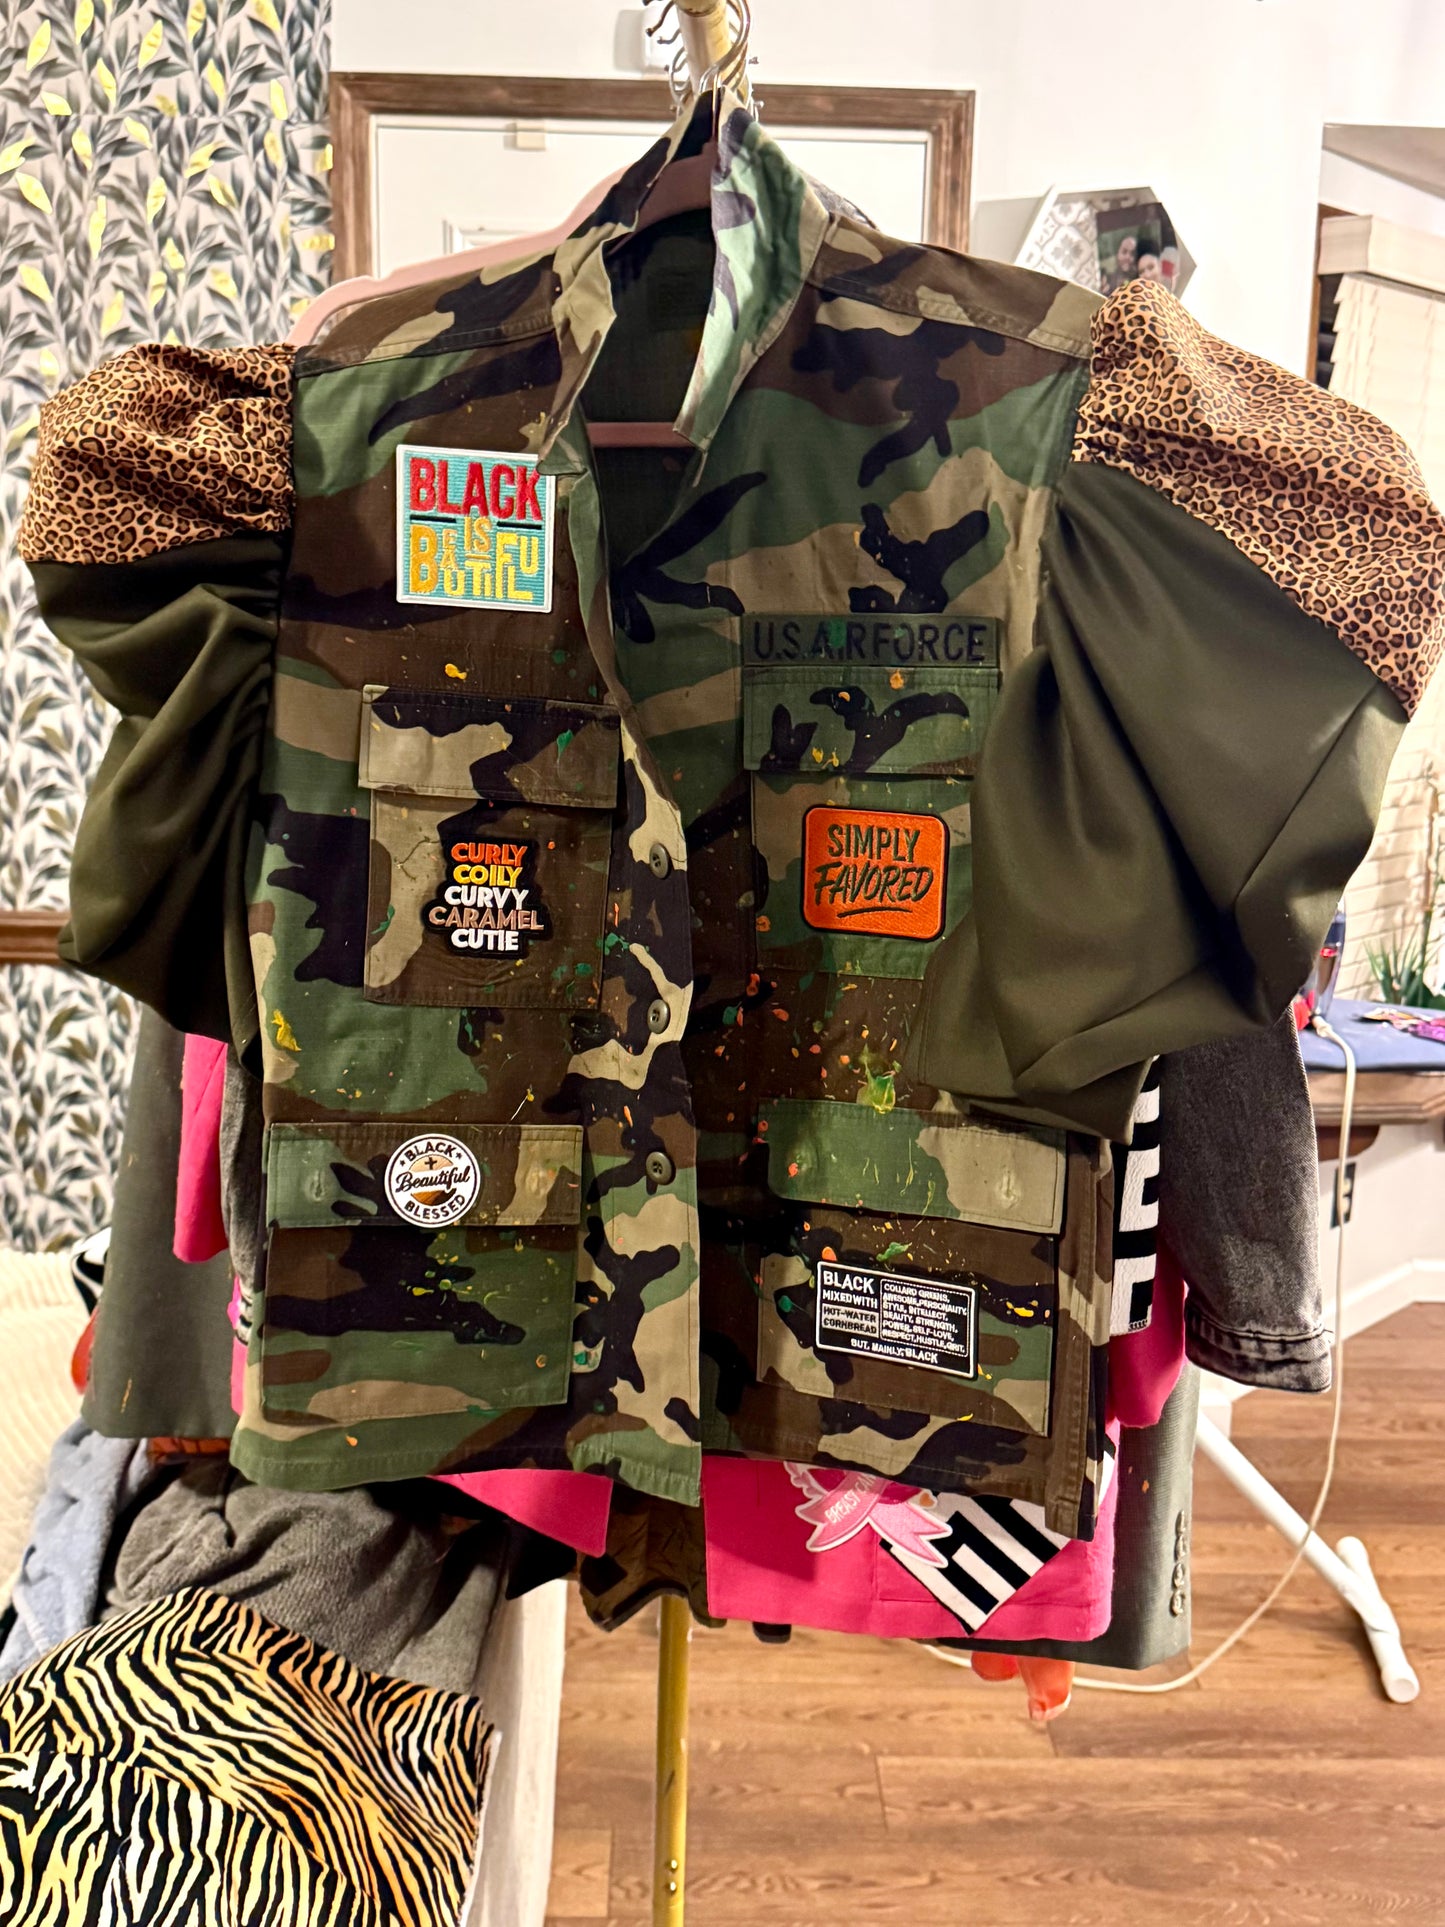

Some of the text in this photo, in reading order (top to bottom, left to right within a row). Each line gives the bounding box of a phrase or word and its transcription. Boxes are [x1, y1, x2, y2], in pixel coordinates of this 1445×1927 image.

[410, 457, 543, 520] BLACK
[464, 517, 492, 552] IS
[811, 620, 866, 660] AR
[872, 622, 987, 662] FORCE
[451, 842, 528, 866] CURLY
[827, 823, 920, 863] SIMPLY
[453, 864, 523, 888] COILY
[814, 861, 934, 906] FAVORED
[444, 885, 529, 910] CURVY
[428, 906, 544, 930] CARAMEL
[451, 928, 519, 951] CUTIE
[404, 1141, 457, 1161] BLACK
[395, 1165, 471, 1193] Beautiful
[404, 1194, 465, 1219] BLESSED
[823, 1270, 875, 1294] BLACK
[884, 1283, 917, 1296] COLLARD
[822, 1289, 878, 1309] MIXED WITH
[823, 1306, 876, 1322] HOT-WATER
[823, 1318, 876, 1334] CORNBREAD
[905, 1347, 938, 1364] BLACK
[824, 1489, 861, 1524] BREAST
